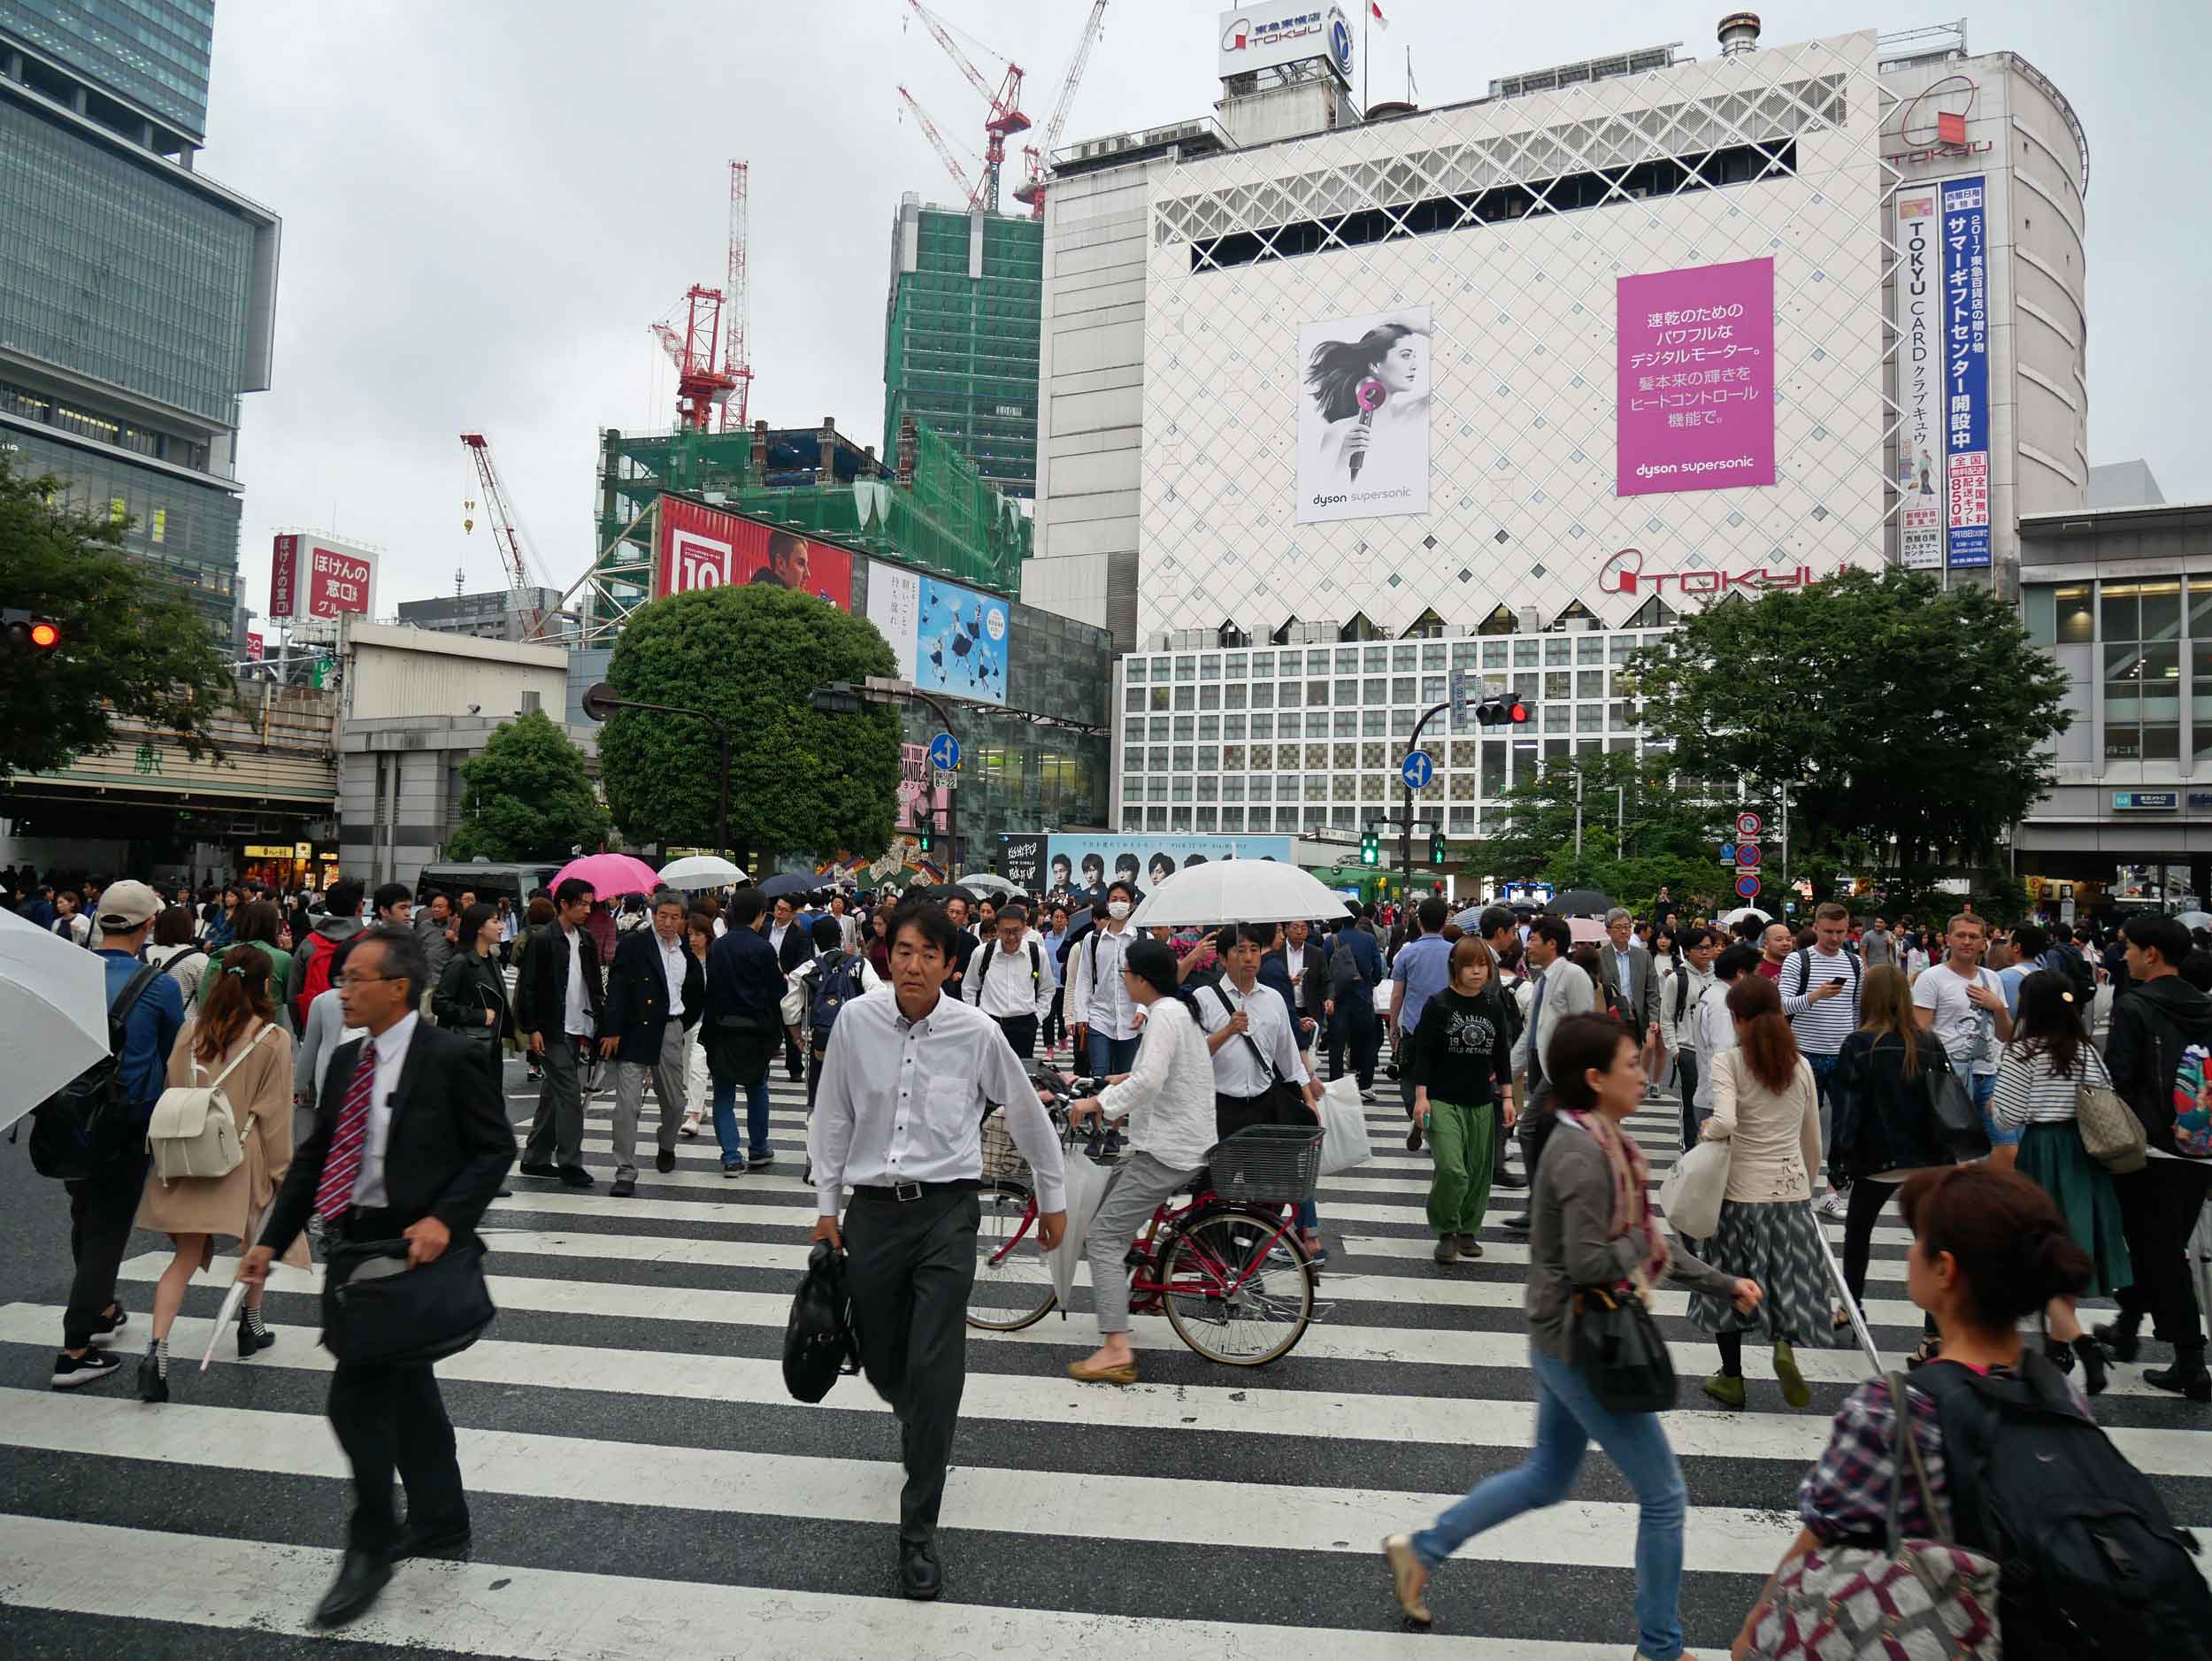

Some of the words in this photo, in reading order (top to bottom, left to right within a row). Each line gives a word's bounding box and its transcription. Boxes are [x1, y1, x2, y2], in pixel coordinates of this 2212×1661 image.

[1248, 23, 1323, 47] TOKYU
[1886, 141, 1993, 165] TOKYU
[1909, 222, 1926, 296] TOKYU
[1647, 304, 1743, 328] 速乾のための
[1656, 325, 1733, 346] パワフルな
[1911, 301, 1927, 362] CARD
[1948, 217, 1971, 449] サマーギフトセンター開設中
[1631, 343, 1760, 368] デジタルモーター。
[1639, 366, 1751, 391] 髪本来の輝きを
[1631, 386, 1759, 411] ヒートコントロール
[1913, 365, 1928, 445] クラブキュウ
[1668, 410, 1723, 428] 機能で。
[1636, 463, 1678, 479] dyson
[1681, 455, 1755, 474] supersonic
[1313, 494, 1348, 507] dyson
[1350, 486, 1413, 503] supersonic
[314, 554, 368, 583] ほけんの
